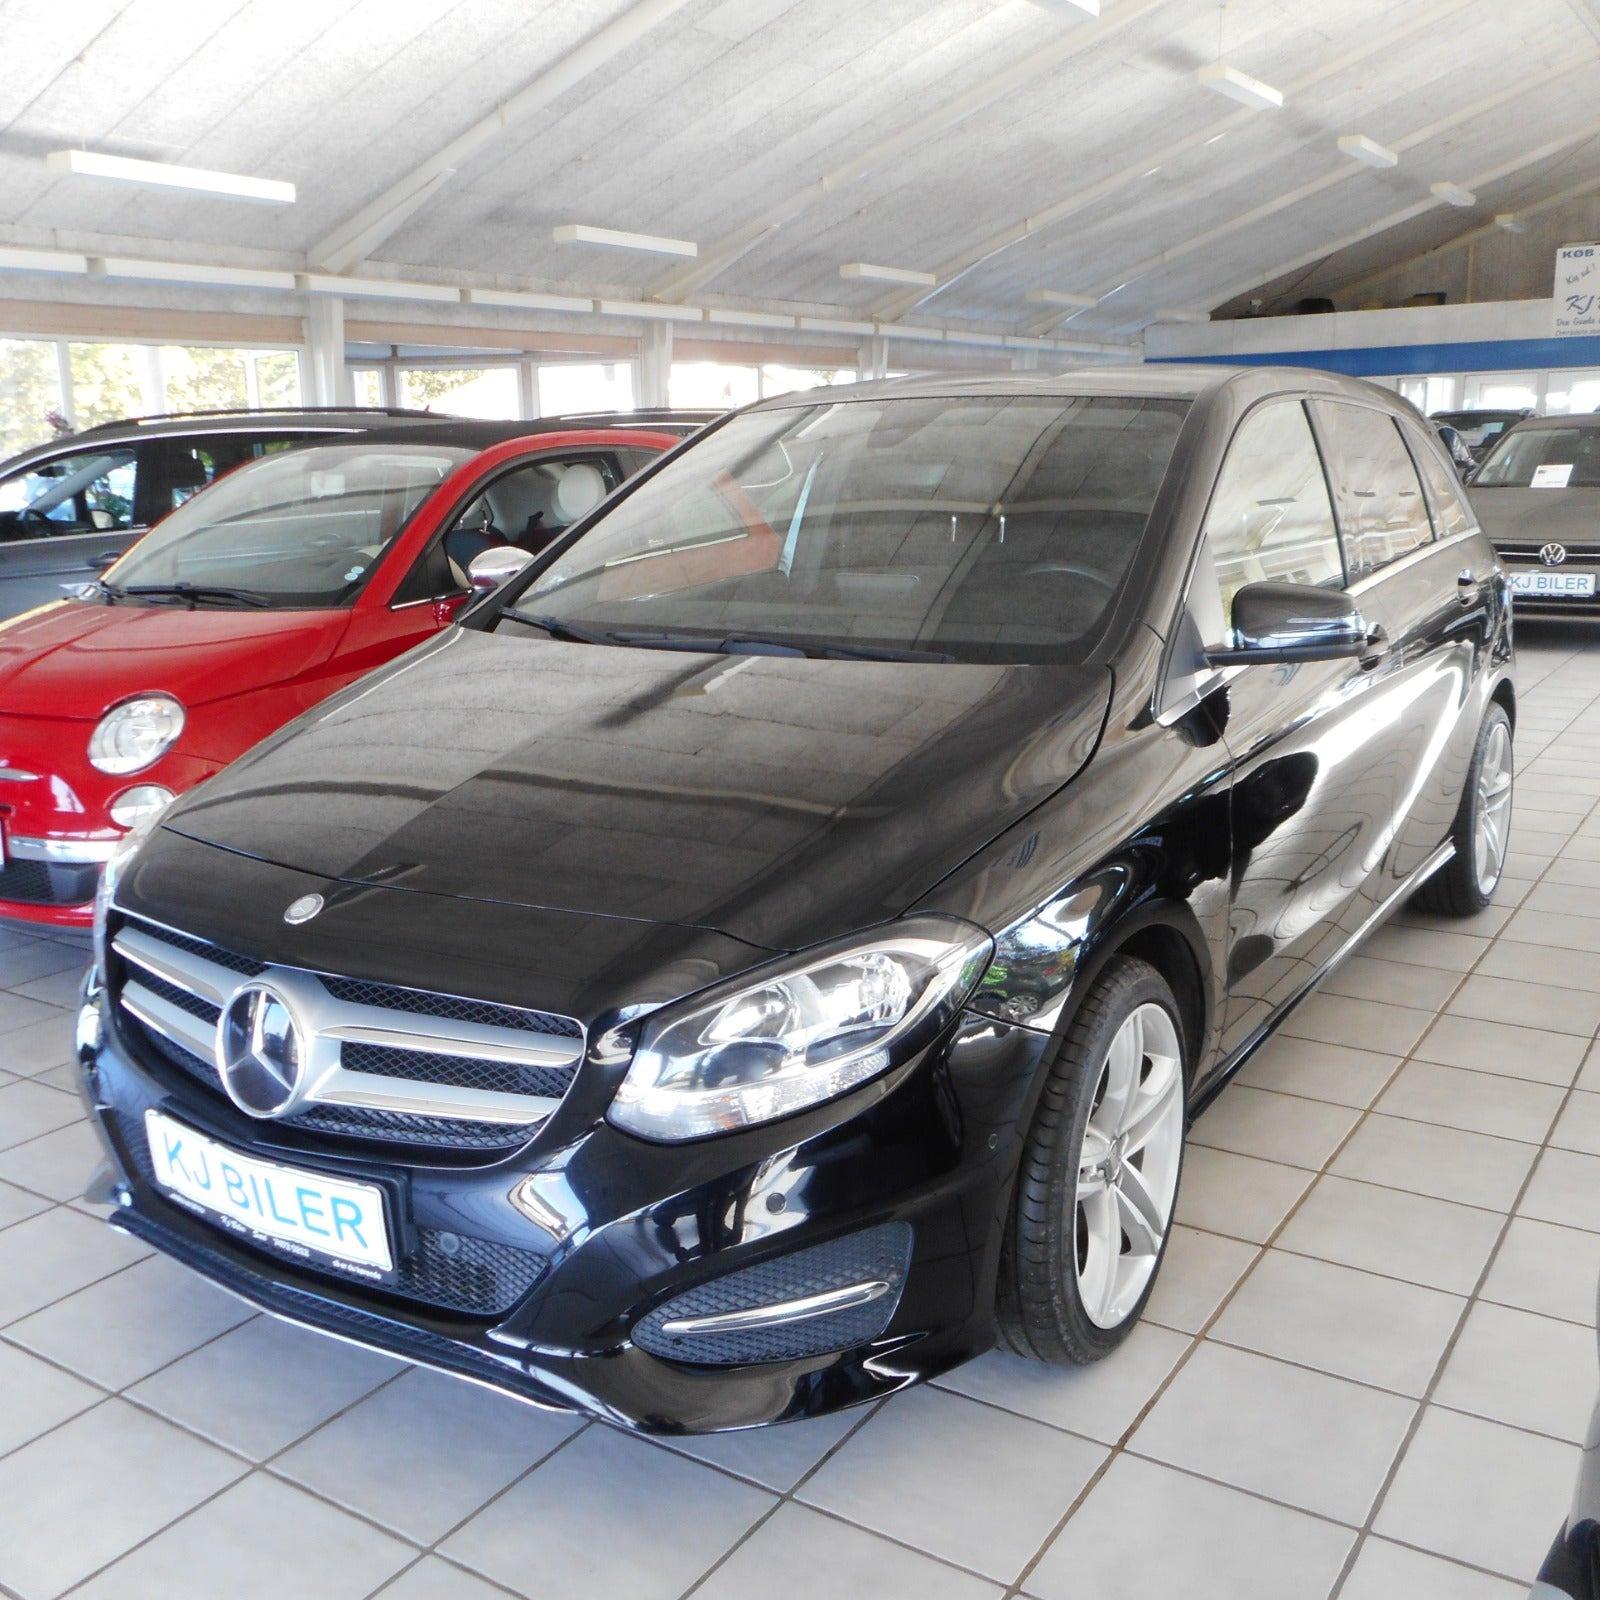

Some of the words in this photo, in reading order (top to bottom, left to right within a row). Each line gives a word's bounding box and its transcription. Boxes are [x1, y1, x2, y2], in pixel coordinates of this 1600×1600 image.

[1566, 295, 1595, 315] KJ
[1511, 576, 1531, 589] KJ
[1537, 576, 1588, 590] BILER
[163, 1131, 212, 1190] KJ
[220, 1161, 368, 1249] BILER
